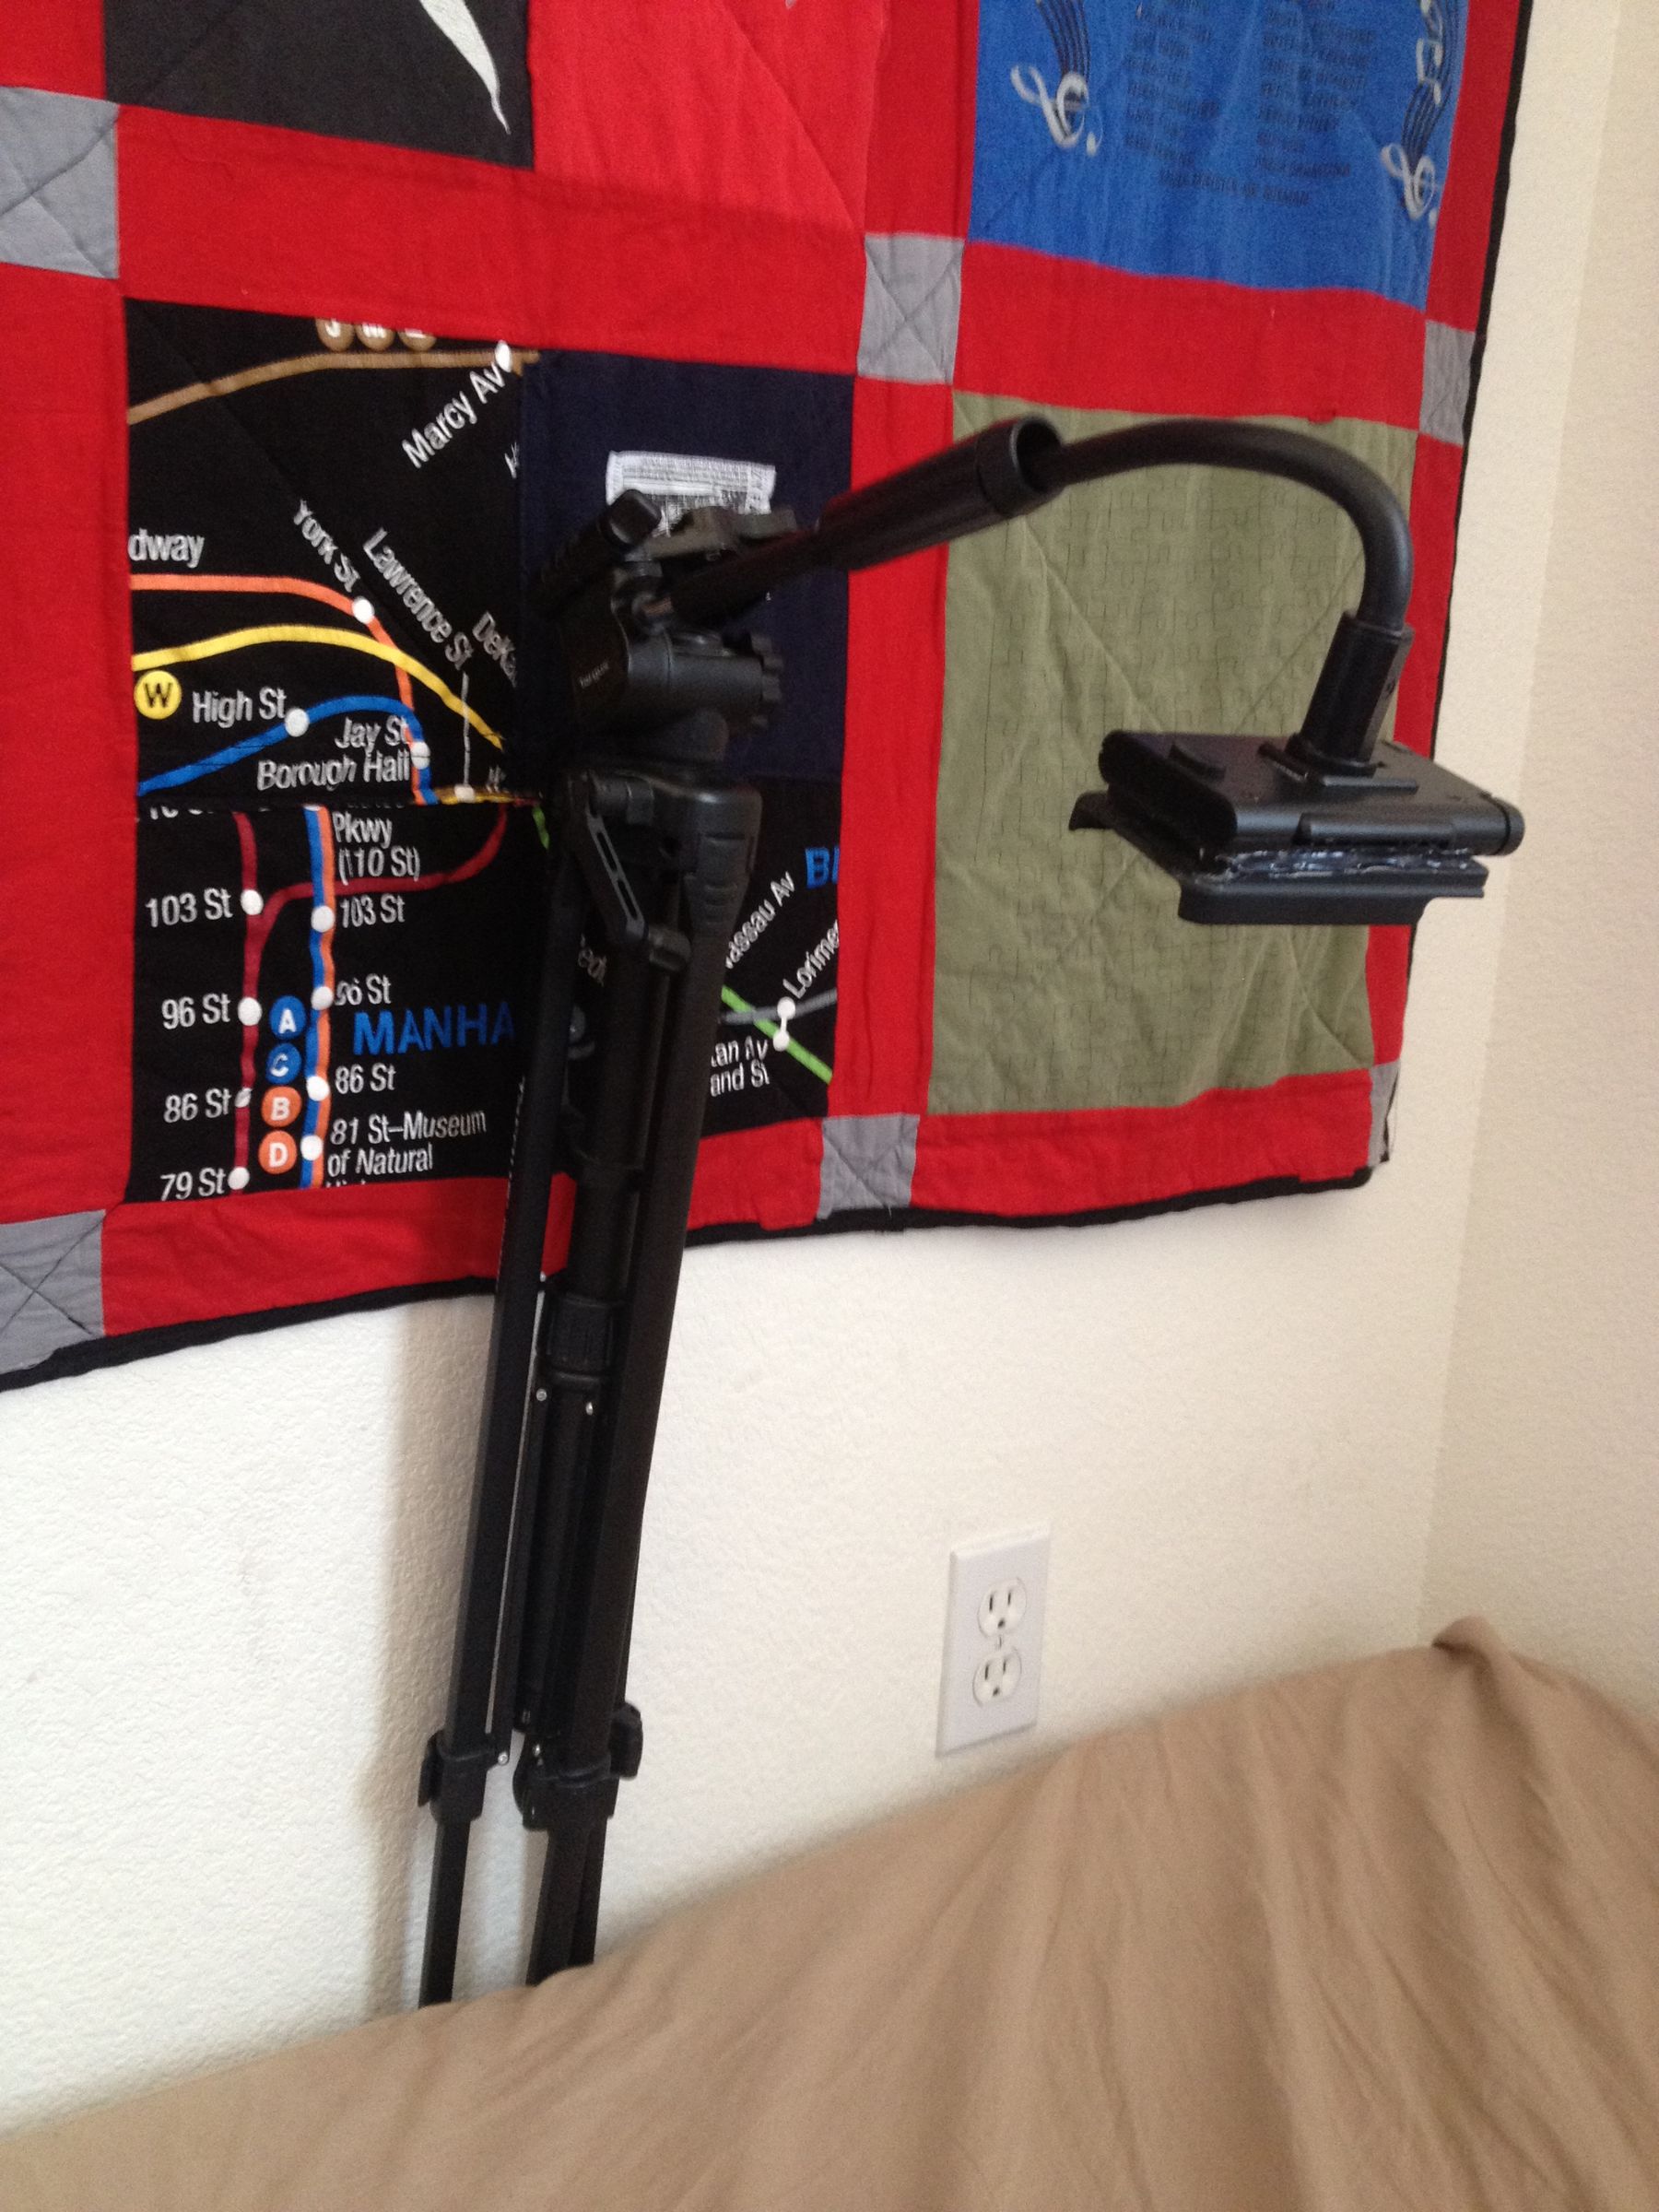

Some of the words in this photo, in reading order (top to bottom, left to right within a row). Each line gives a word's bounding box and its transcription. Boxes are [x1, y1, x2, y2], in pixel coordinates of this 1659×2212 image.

[402, 391, 477, 468] Marcy
[469, 361, 505, 404] Av
[128, 527, 205, 568] dway
[293, 499, 337, 565] York
[334, 553, 360, 593] St
[363, 526, 453, 643] Lawrence
[444, 631, 474, 671] St
[144, 682, 173, 708] W
[192, 689, 253, 729] High
[259, 686, 287, 719] St
[335, 716, 381, 756] Jay
[385, 715, 409, 747] St
[257, 755, 357, 792] Borough
[363, 749, 410, 782] Hall
[332, 811, 393, 849] Pkwy
[391, 845, 420, 882] St)
[771, 871, 794, 907] Av
[145, 892, 198, 928] 103
[204, 888, 233, 920] St
[340, 895, 376, 928] 103
[380, 893, 406, 924] St
[366, 973, 392, 1005] St
[161, 996, 195, 1030] 96
[202, 993, 230, 1024] St
[278, 1008, 297, 1033] A
[270, 1053, 289, 1077] C
[711, 1040, 739, 1067] an
[745, 1035, 769, 1060] Av
[335, 1064, 364, 1094] 86
[370, 1063, 396, 1091] St
[163, 1093, 198, 1124] 86
[206, 1088, 231, 1118] St
[271, 1097, 290, 1121] B
[330, 1117, 359, 1145] 81
[269, 1142, 288, 1168] D
[327, 1149, 350, 1177] of
[355, 1142, 433, 1175] Natural
[160, 1171, 194, 1202] 79
[198, 1167, 227, 1196] St
